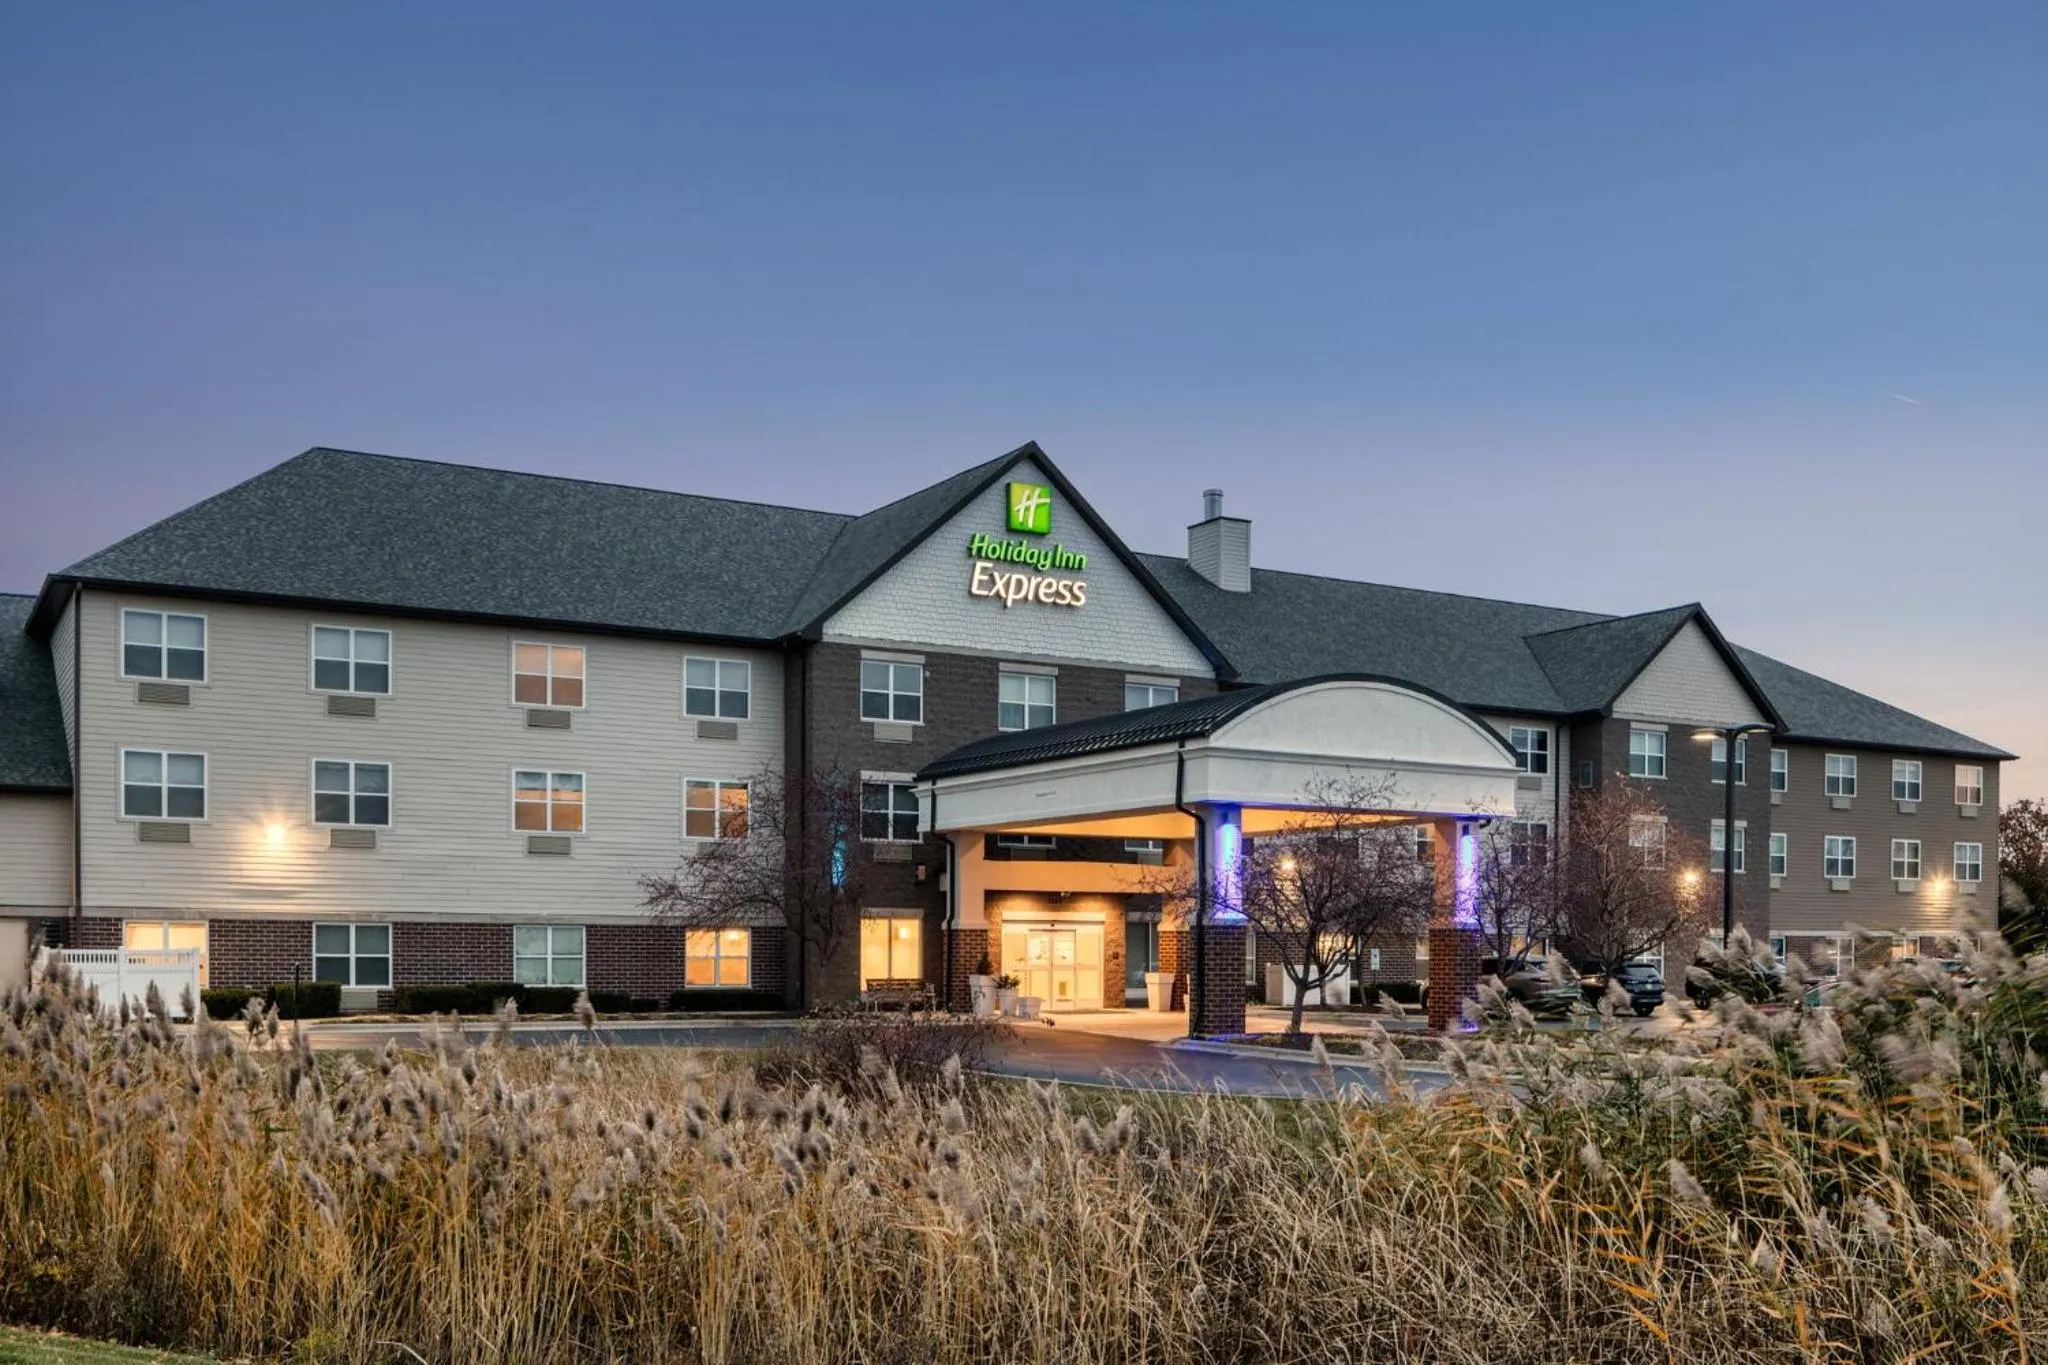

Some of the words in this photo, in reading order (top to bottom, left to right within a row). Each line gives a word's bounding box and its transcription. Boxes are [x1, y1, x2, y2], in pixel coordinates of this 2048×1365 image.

[970, 533, 1052, 570] Holiday
[1055, 543, 1087, 570] Inn
[971, 561, 1087, 608] Express
